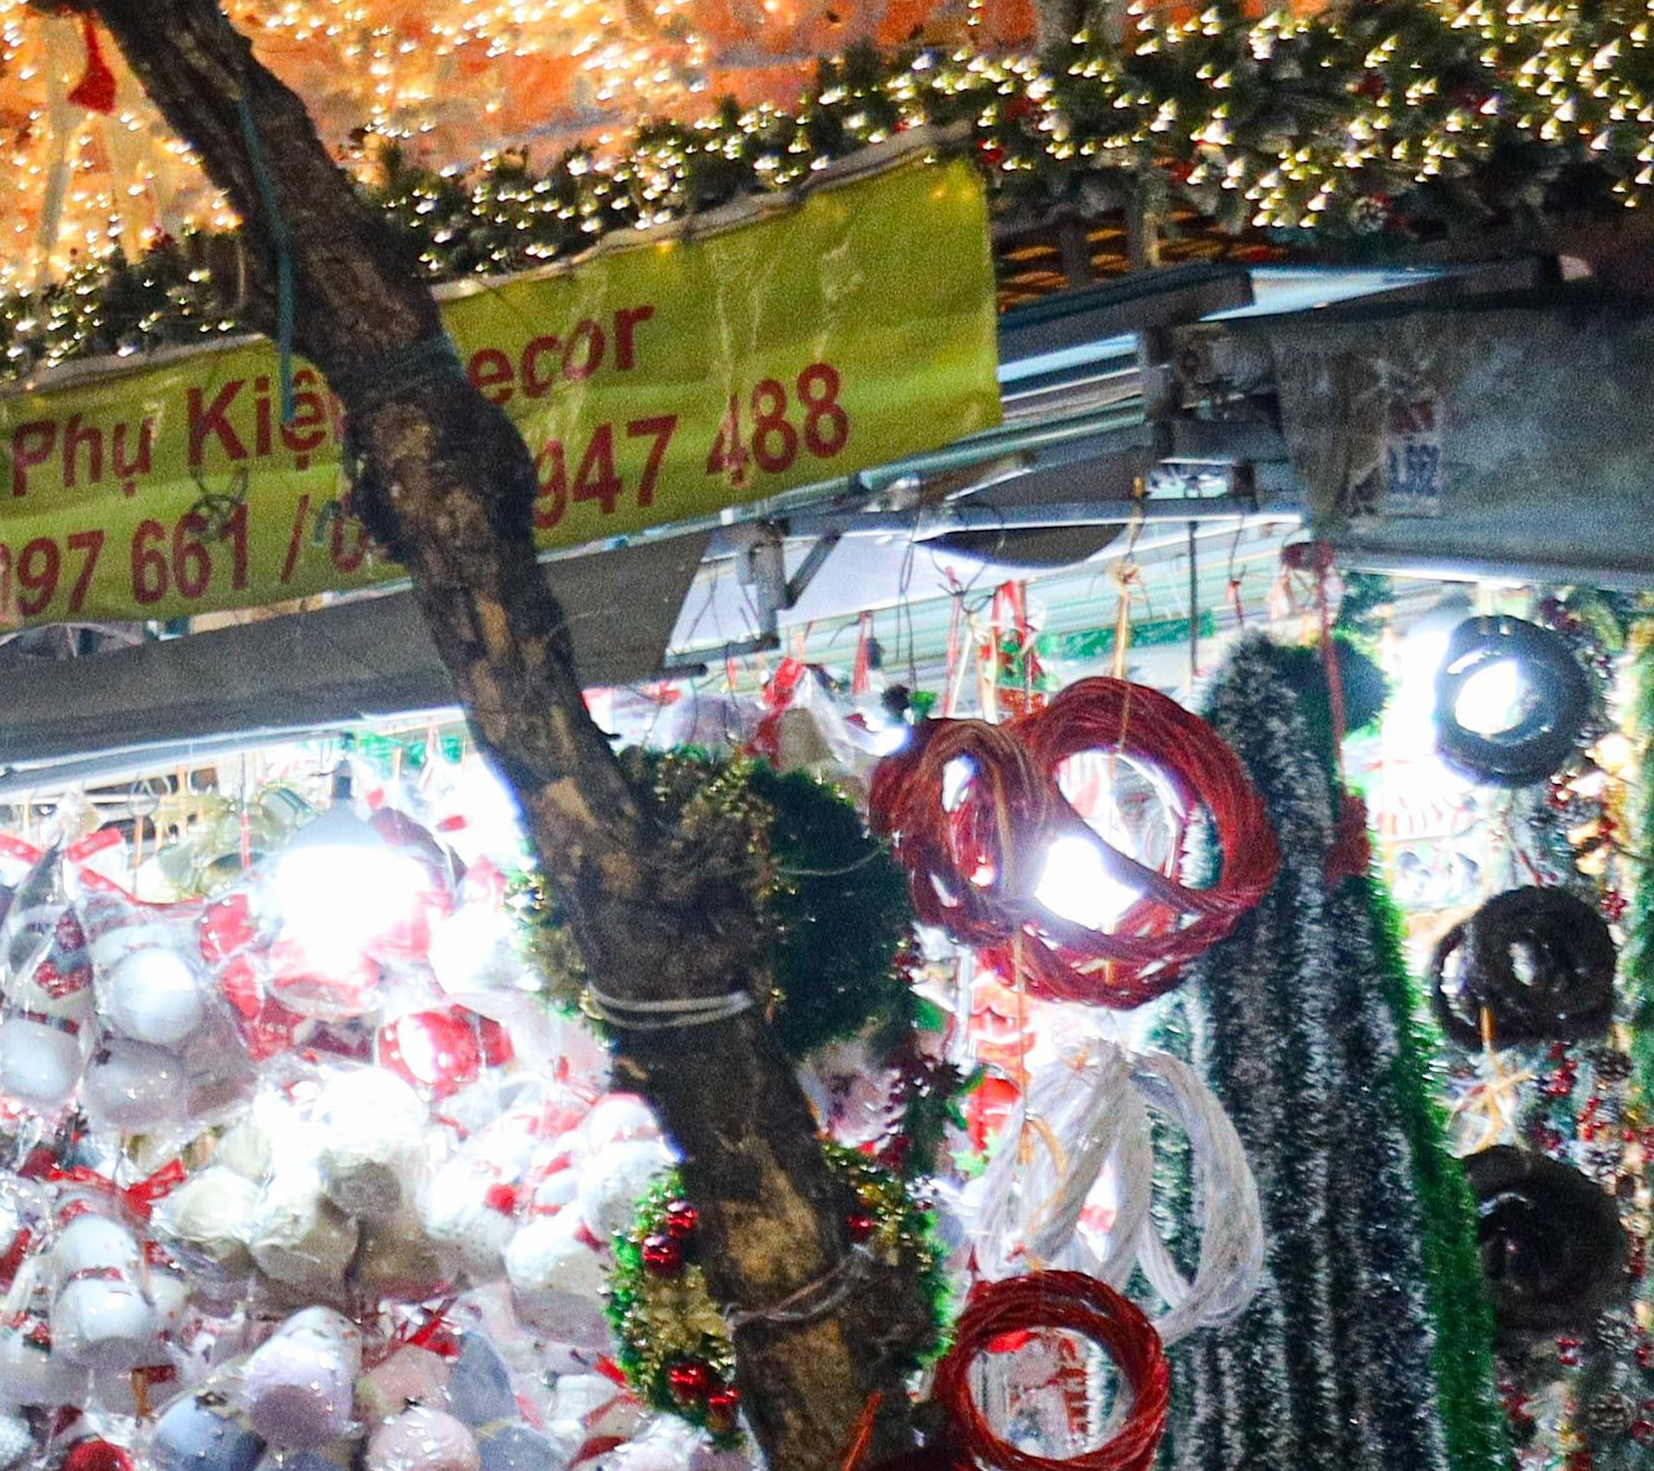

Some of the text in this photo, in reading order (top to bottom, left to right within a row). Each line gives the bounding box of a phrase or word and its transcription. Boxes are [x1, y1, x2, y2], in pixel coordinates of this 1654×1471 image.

[13, 412, 154, 497] Phụ
[186, 368, 346, 471] Kiệ
[467, 305, 655, 406] ecor
[706, 361, 849, 488] 488
